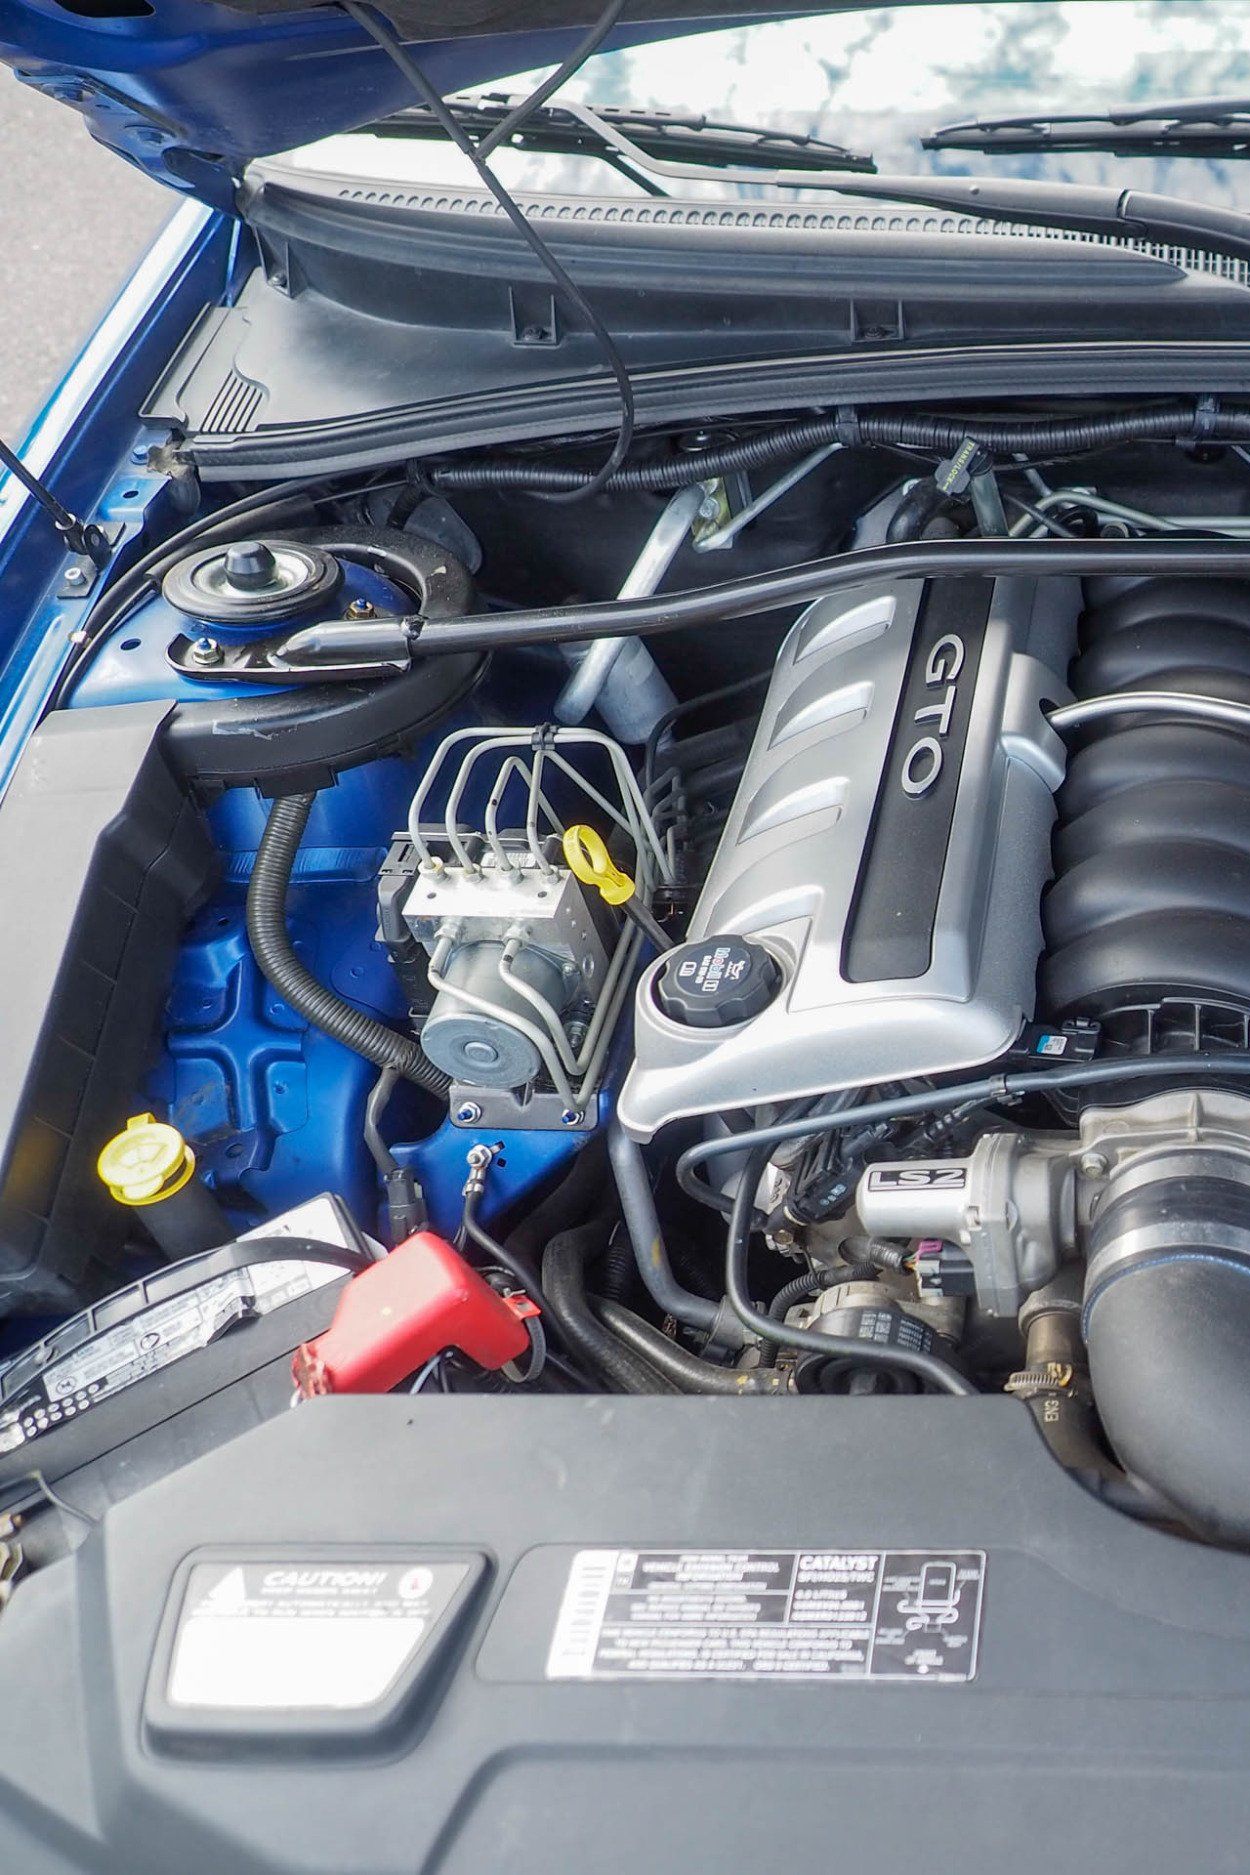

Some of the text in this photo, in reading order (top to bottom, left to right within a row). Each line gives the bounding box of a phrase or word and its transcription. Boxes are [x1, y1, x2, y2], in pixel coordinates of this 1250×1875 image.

[902, 633, 966, 796] GTO
[869, 1169, 965, 1187] LS2
[799, 1555, 879, 1571] CATALYST
